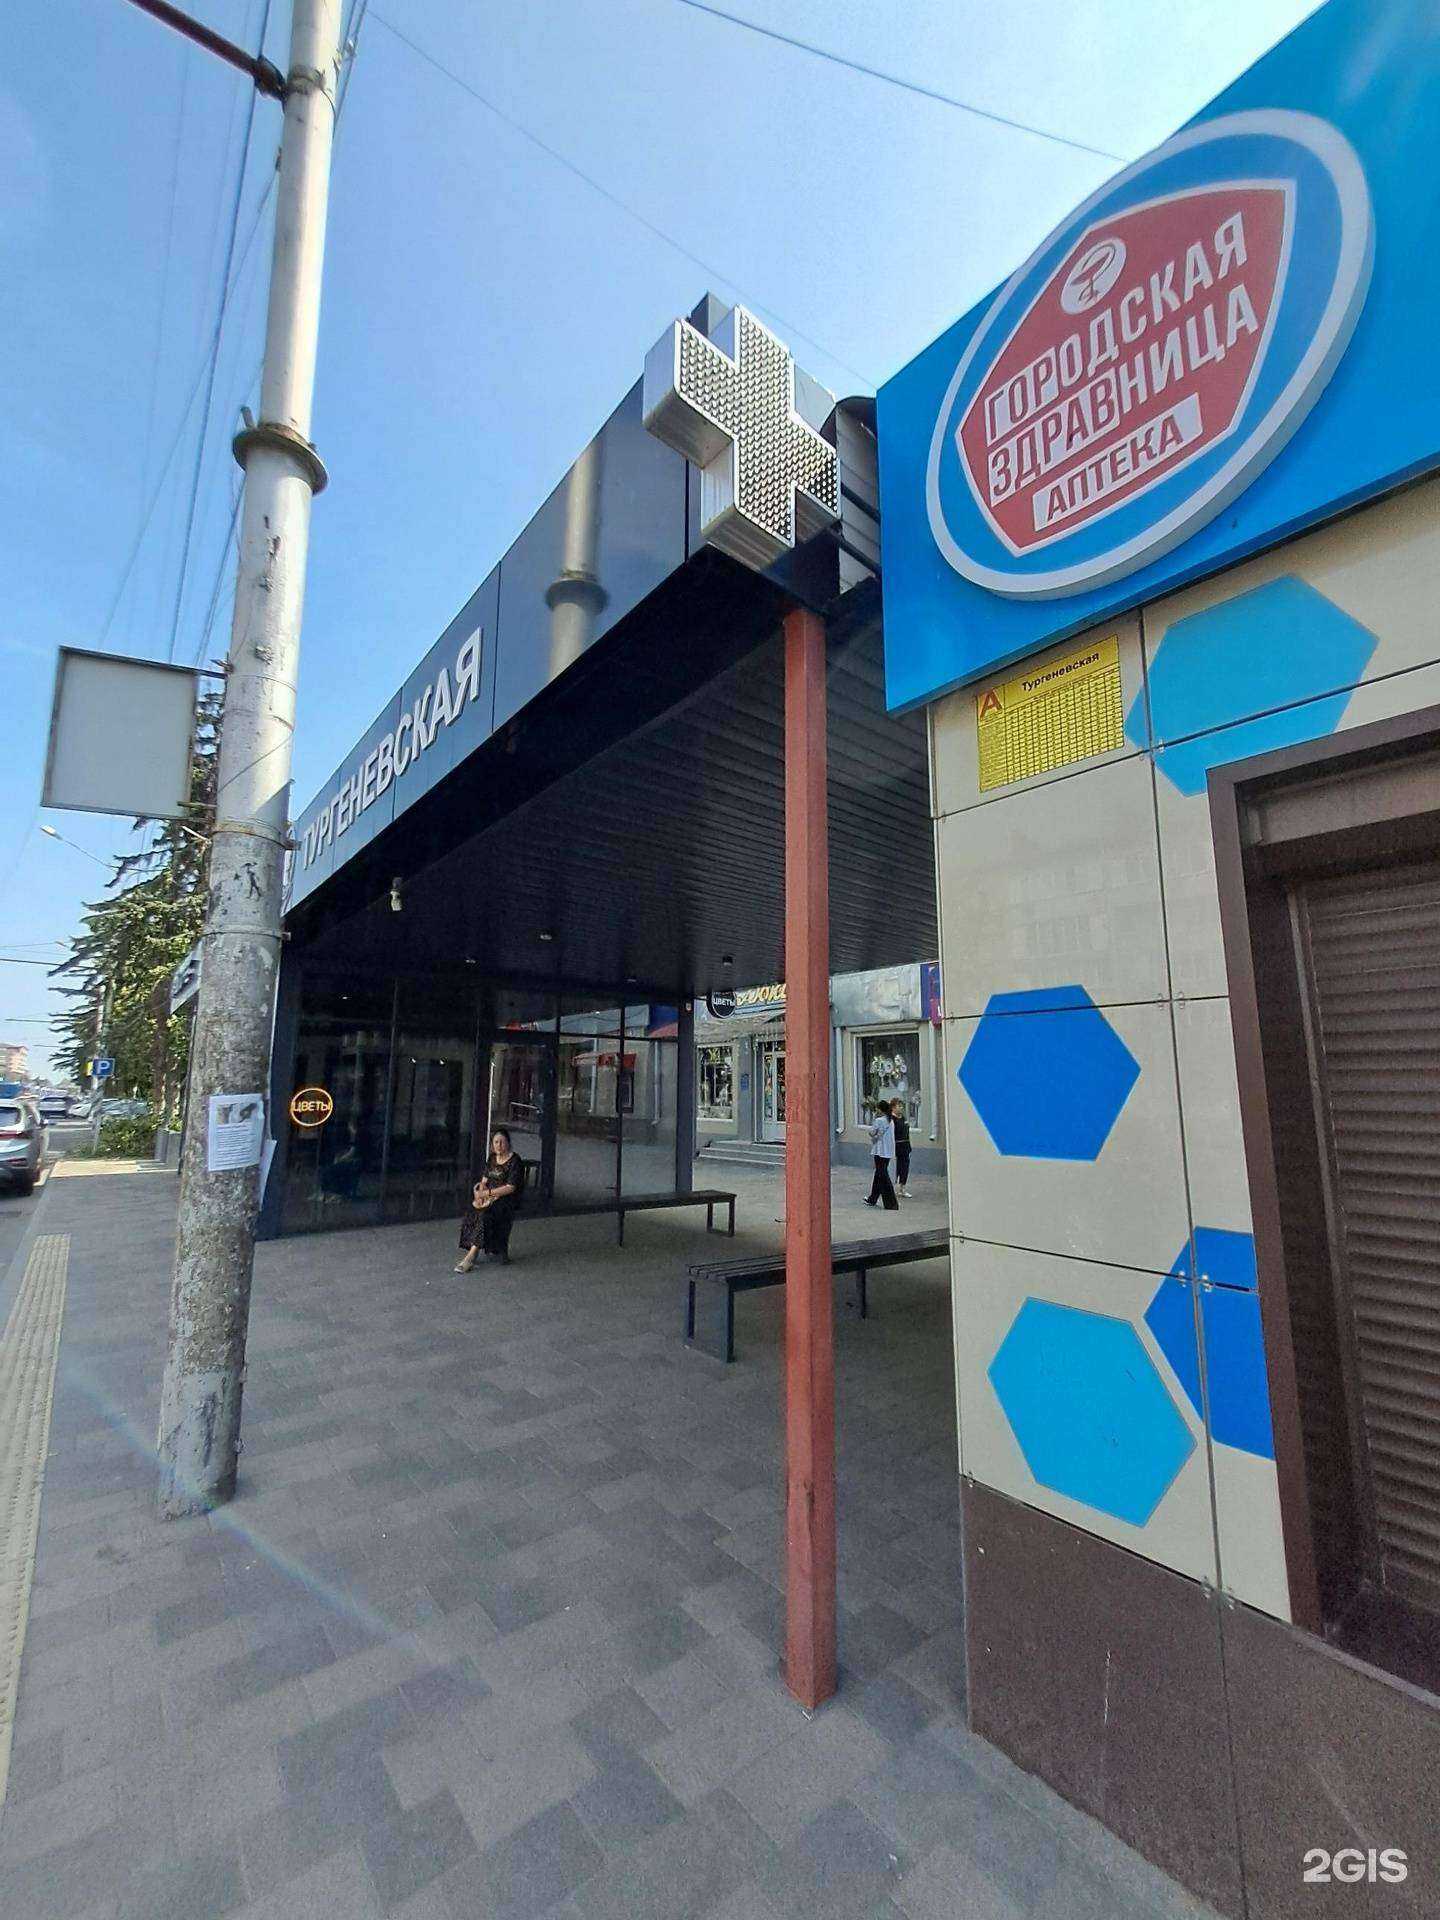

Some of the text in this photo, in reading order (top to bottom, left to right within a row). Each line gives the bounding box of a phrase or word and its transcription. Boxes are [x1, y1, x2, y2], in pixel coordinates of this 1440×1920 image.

[986, 211, 1248, 441] ГОРОДСКАЯ
[989, 283, 1259, 498] ЗДРАВНИЦА
[1046, 412, 1184, 523] АПТЕКА
[303, 625, 484, 870] ТУРГЕНЕВСКАЯ
[1021, 652, 1100, 691] Тургеневская
[292, 1101, 331, 1112] ЦВЕТЫ
